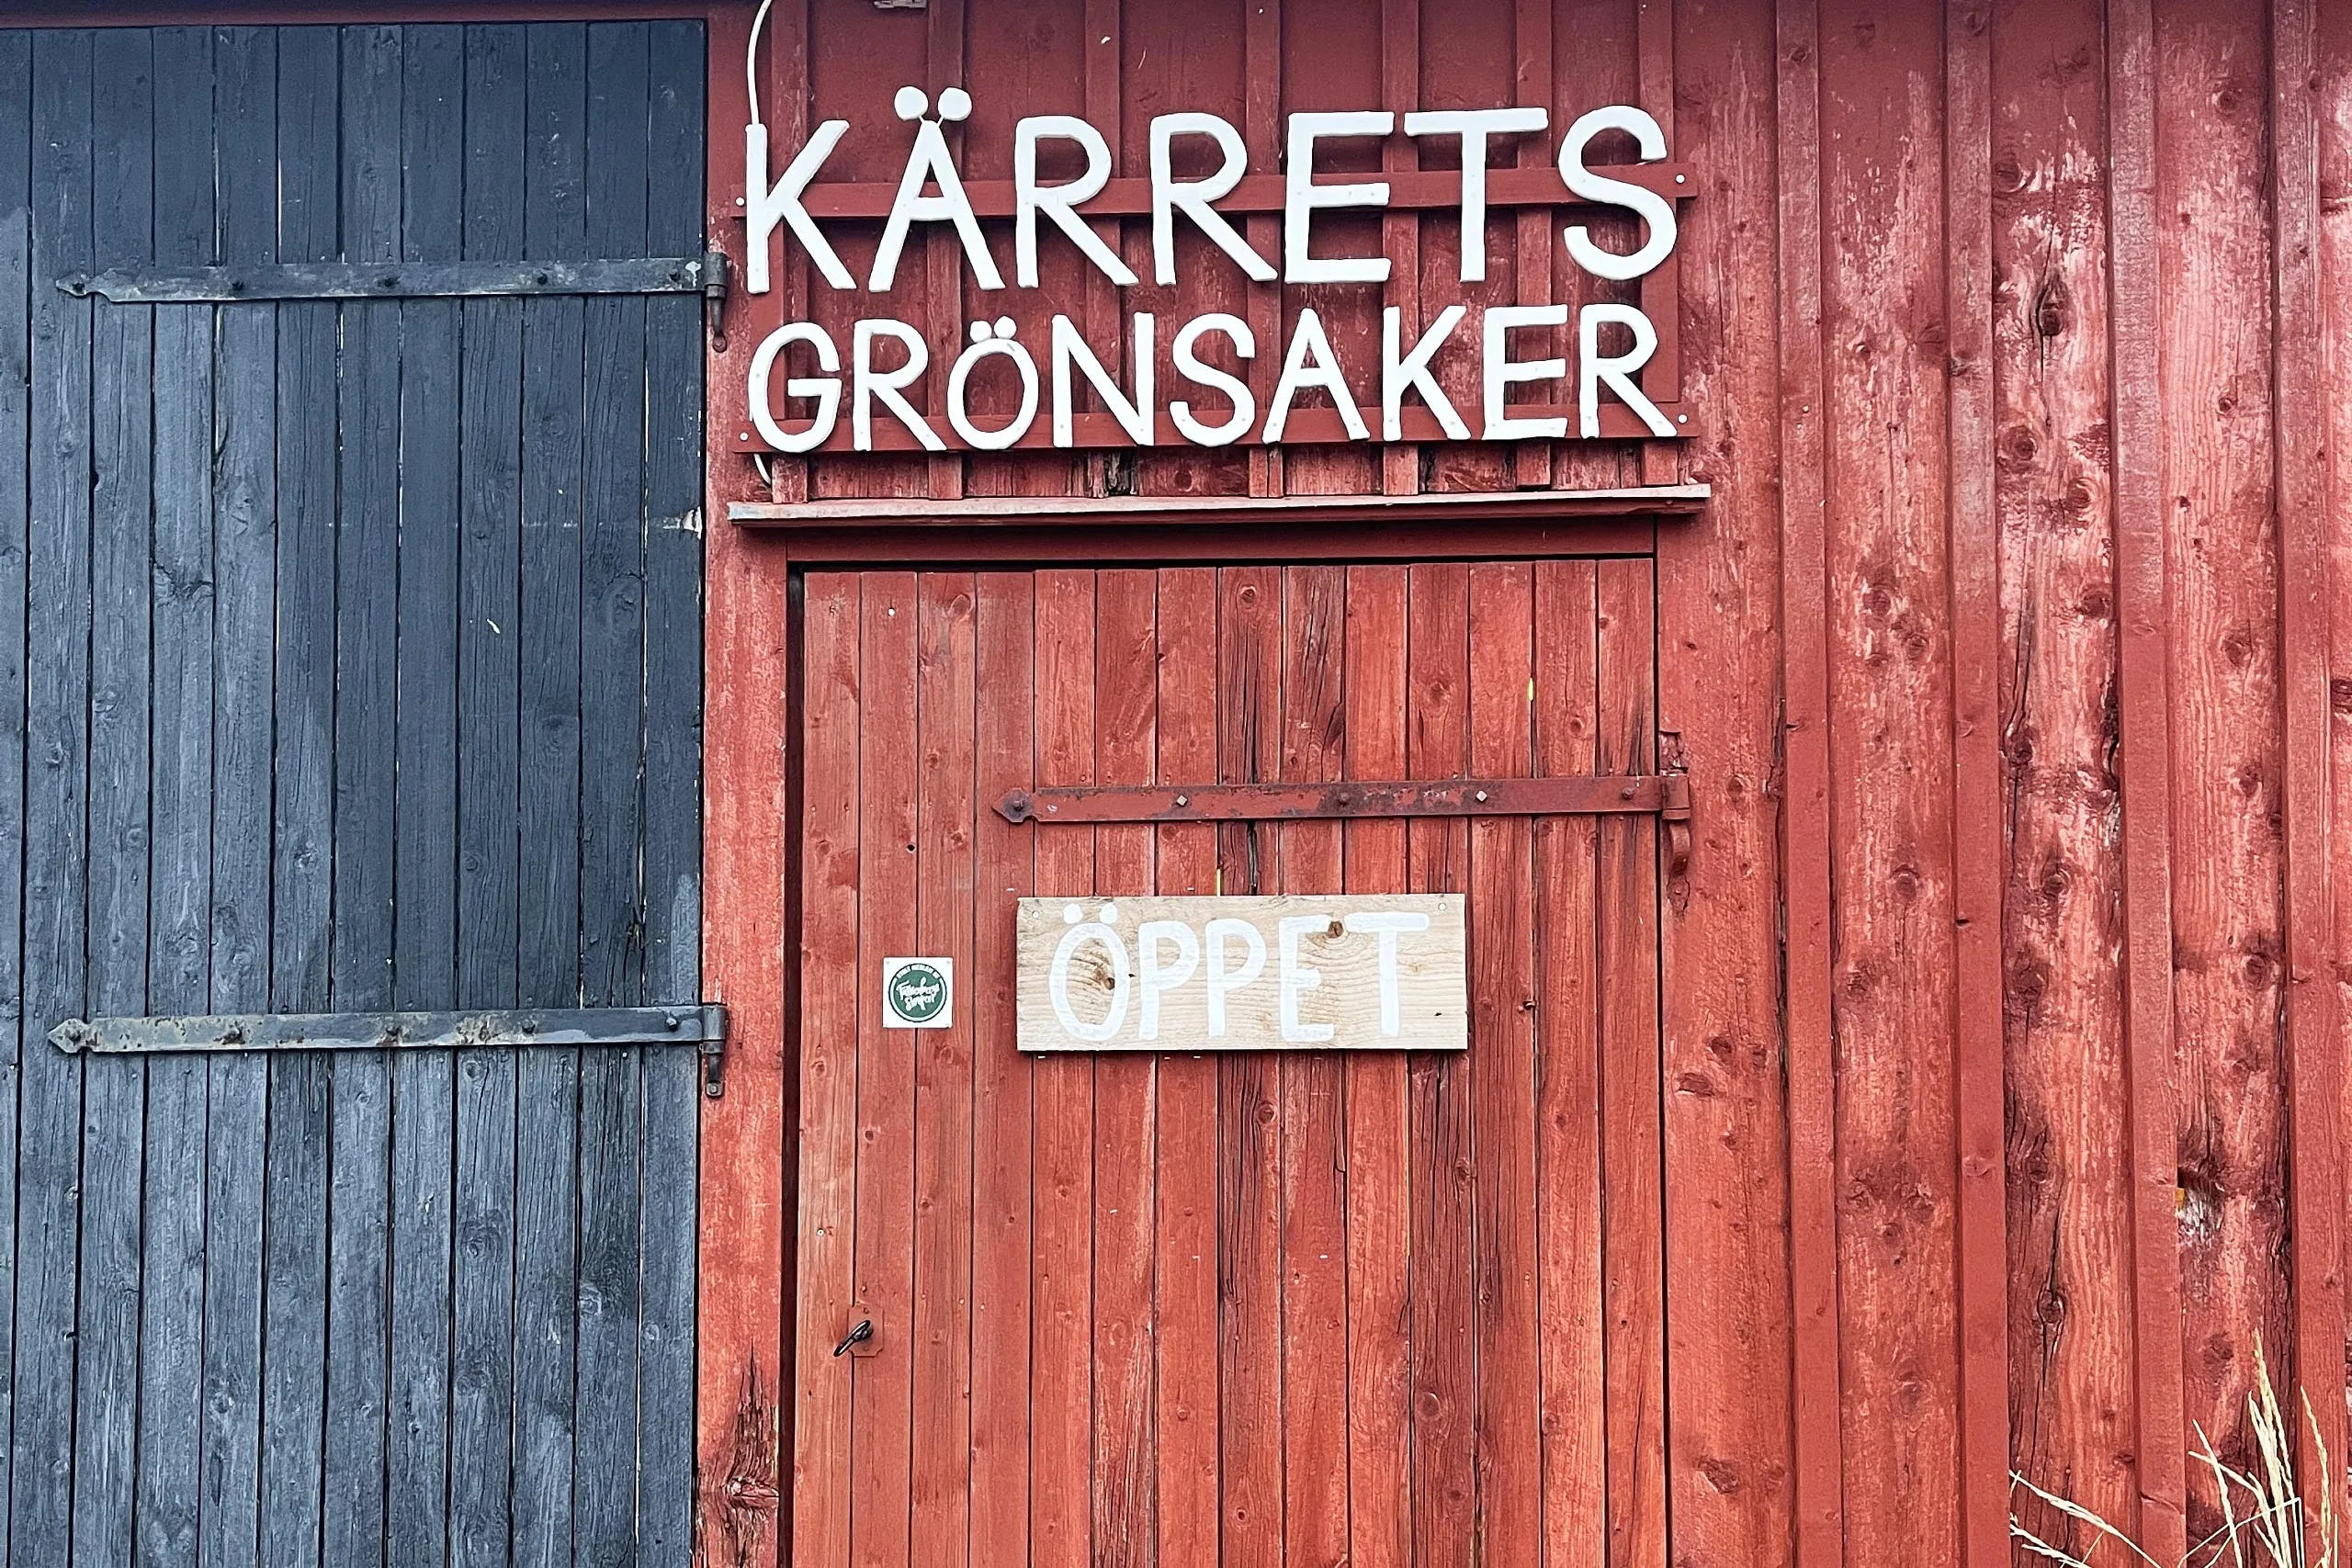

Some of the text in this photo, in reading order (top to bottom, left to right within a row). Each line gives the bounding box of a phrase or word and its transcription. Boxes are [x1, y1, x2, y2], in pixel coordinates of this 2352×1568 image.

[745, 86, 1678, 294] KÄRRETS
[748, 304, 1678, 452] GRÖNSAKER
[1050, 904, 1430, 1041] ÖPPET
